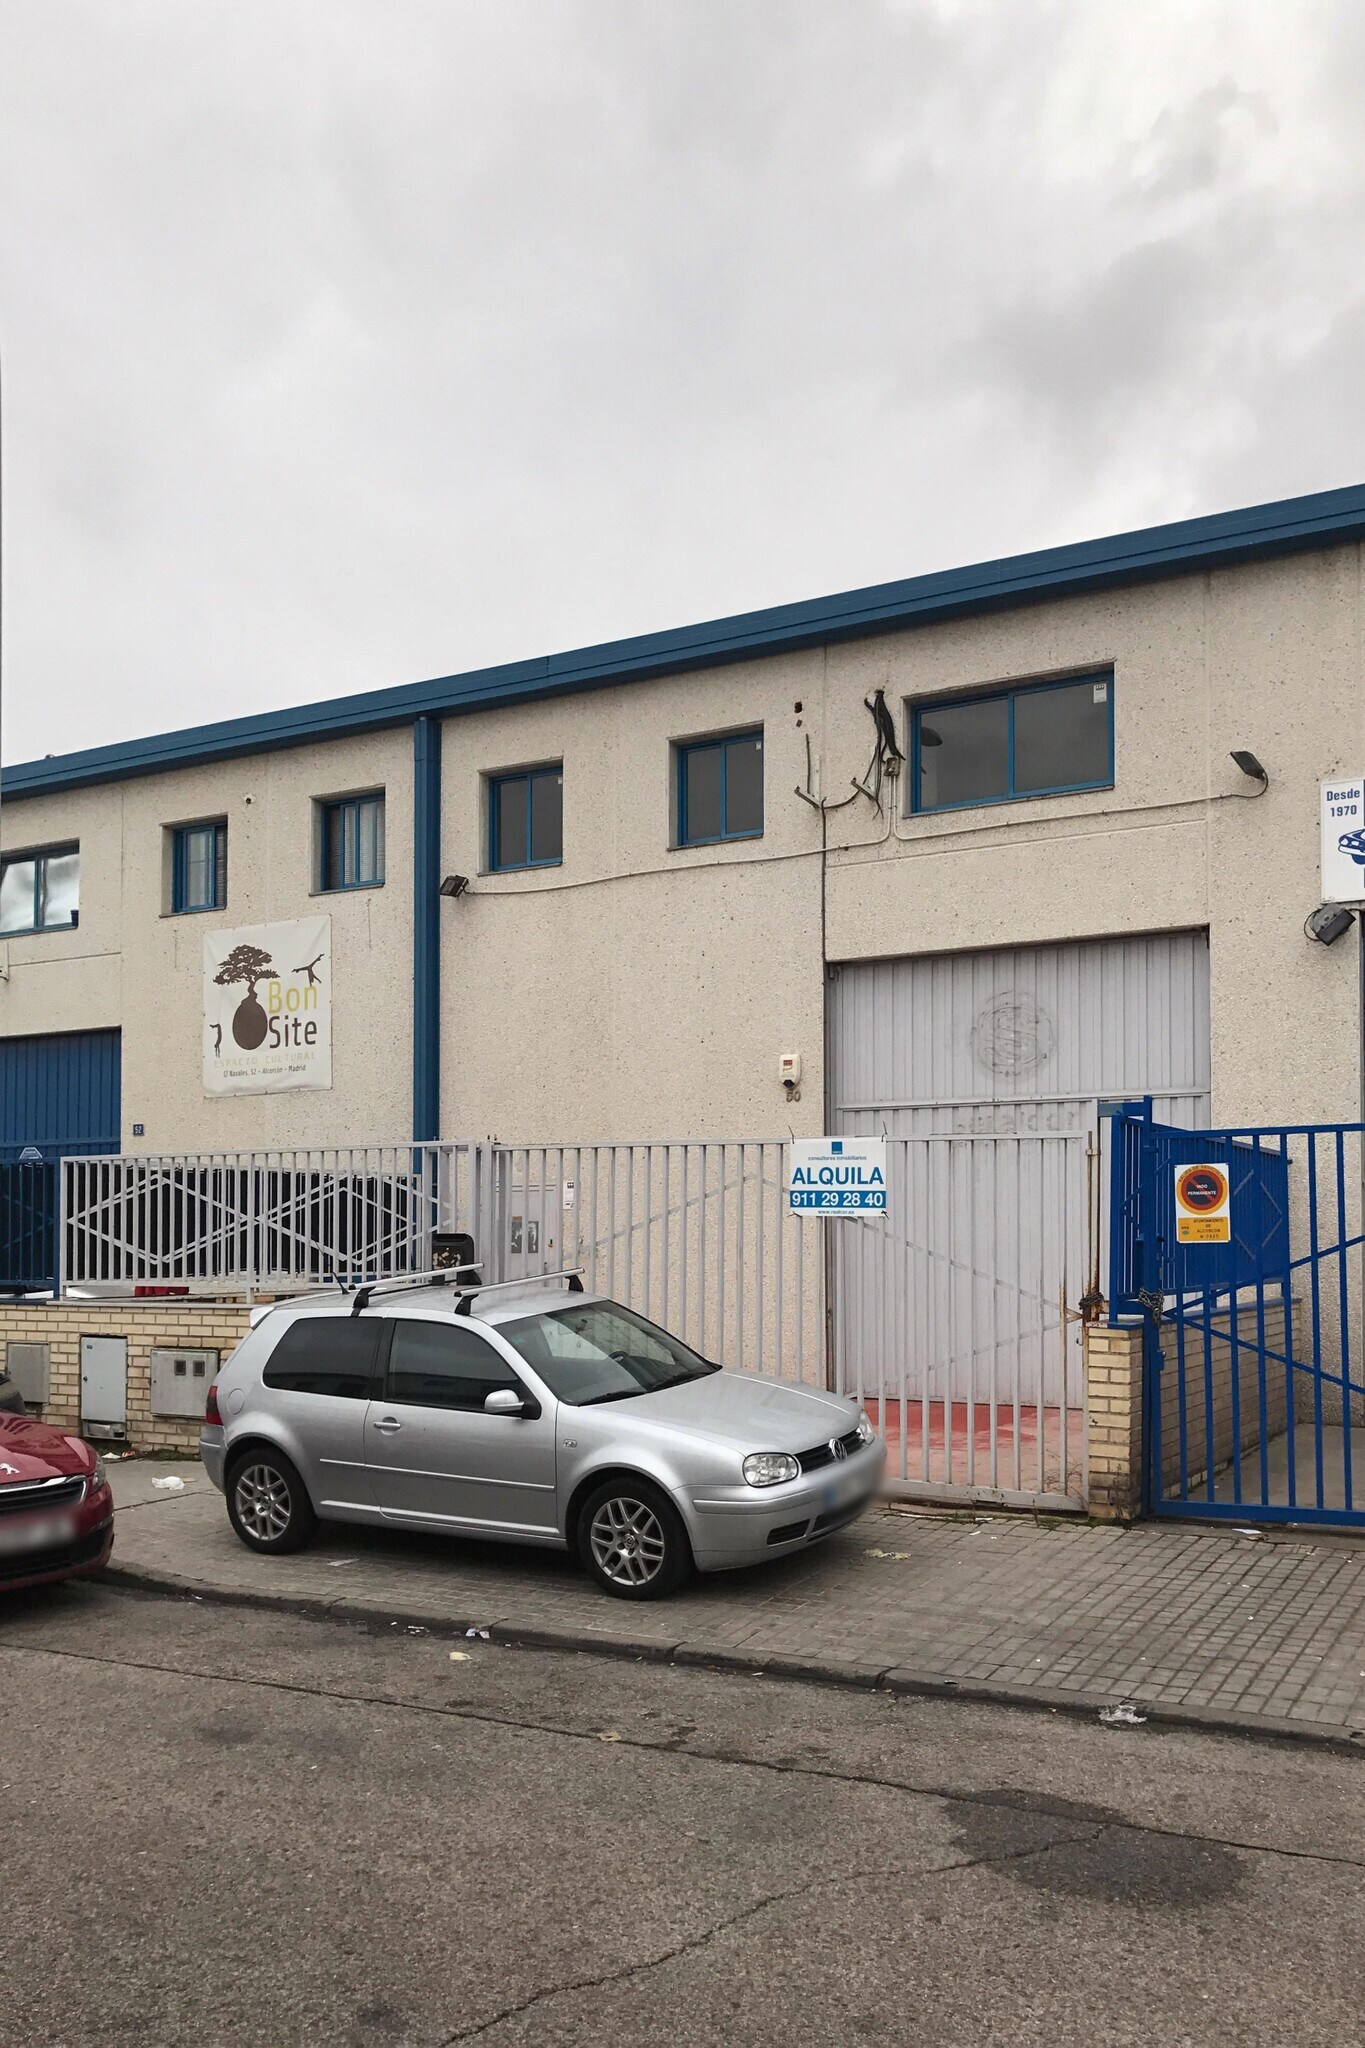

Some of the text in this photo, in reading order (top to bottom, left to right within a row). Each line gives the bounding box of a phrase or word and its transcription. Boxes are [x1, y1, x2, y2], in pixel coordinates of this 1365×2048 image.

[1326, 788, 1360, 801] Desde
[1330, 805, 1357, 817] 1970
[268, 981, 318, 1014] Bon
[268, 1015, 318, 1049] Site
[214, 1052, 316, 1069] ESPACIO CULTURAL
[250, 1068, 257, 1076] 52
[791, 1166, 884, 1186] ALQUILA
[792, 1192, 883, 1206] 911 29 28 40
